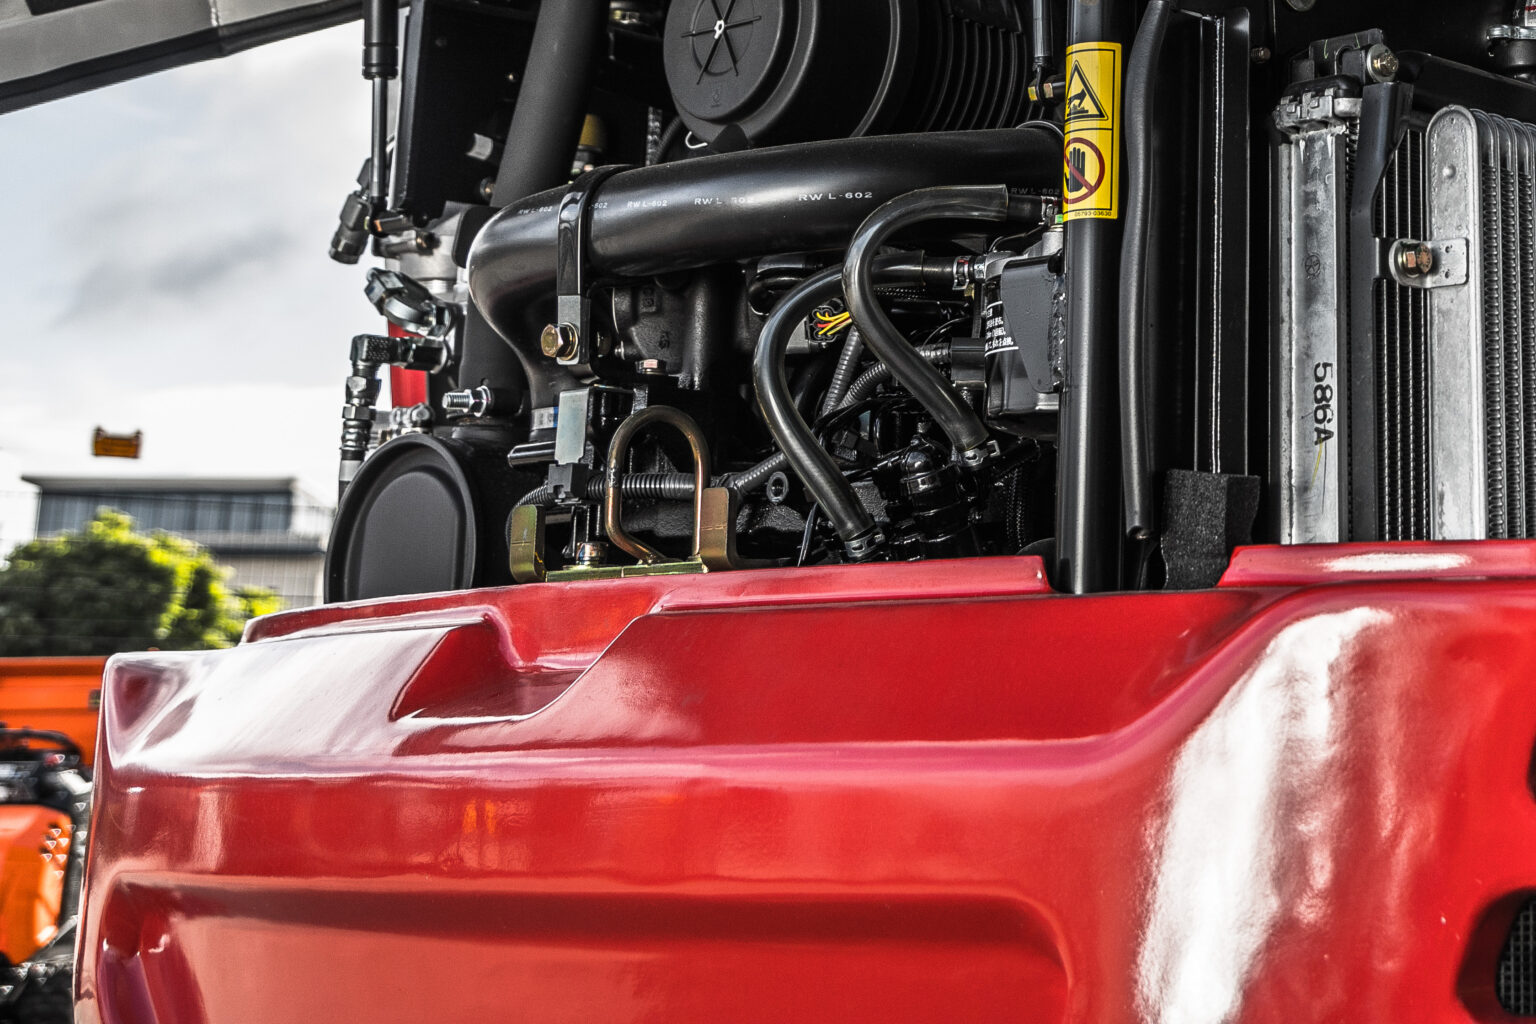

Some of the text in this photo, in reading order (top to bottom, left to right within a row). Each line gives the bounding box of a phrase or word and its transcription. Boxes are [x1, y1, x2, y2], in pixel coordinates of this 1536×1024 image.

[694, 197, 713, 205] RW
[798, 191, 873, 201] RW L-602
[627, 199, 668, 209] RW L-602
[1313, 362, 1335, 446] 586A
